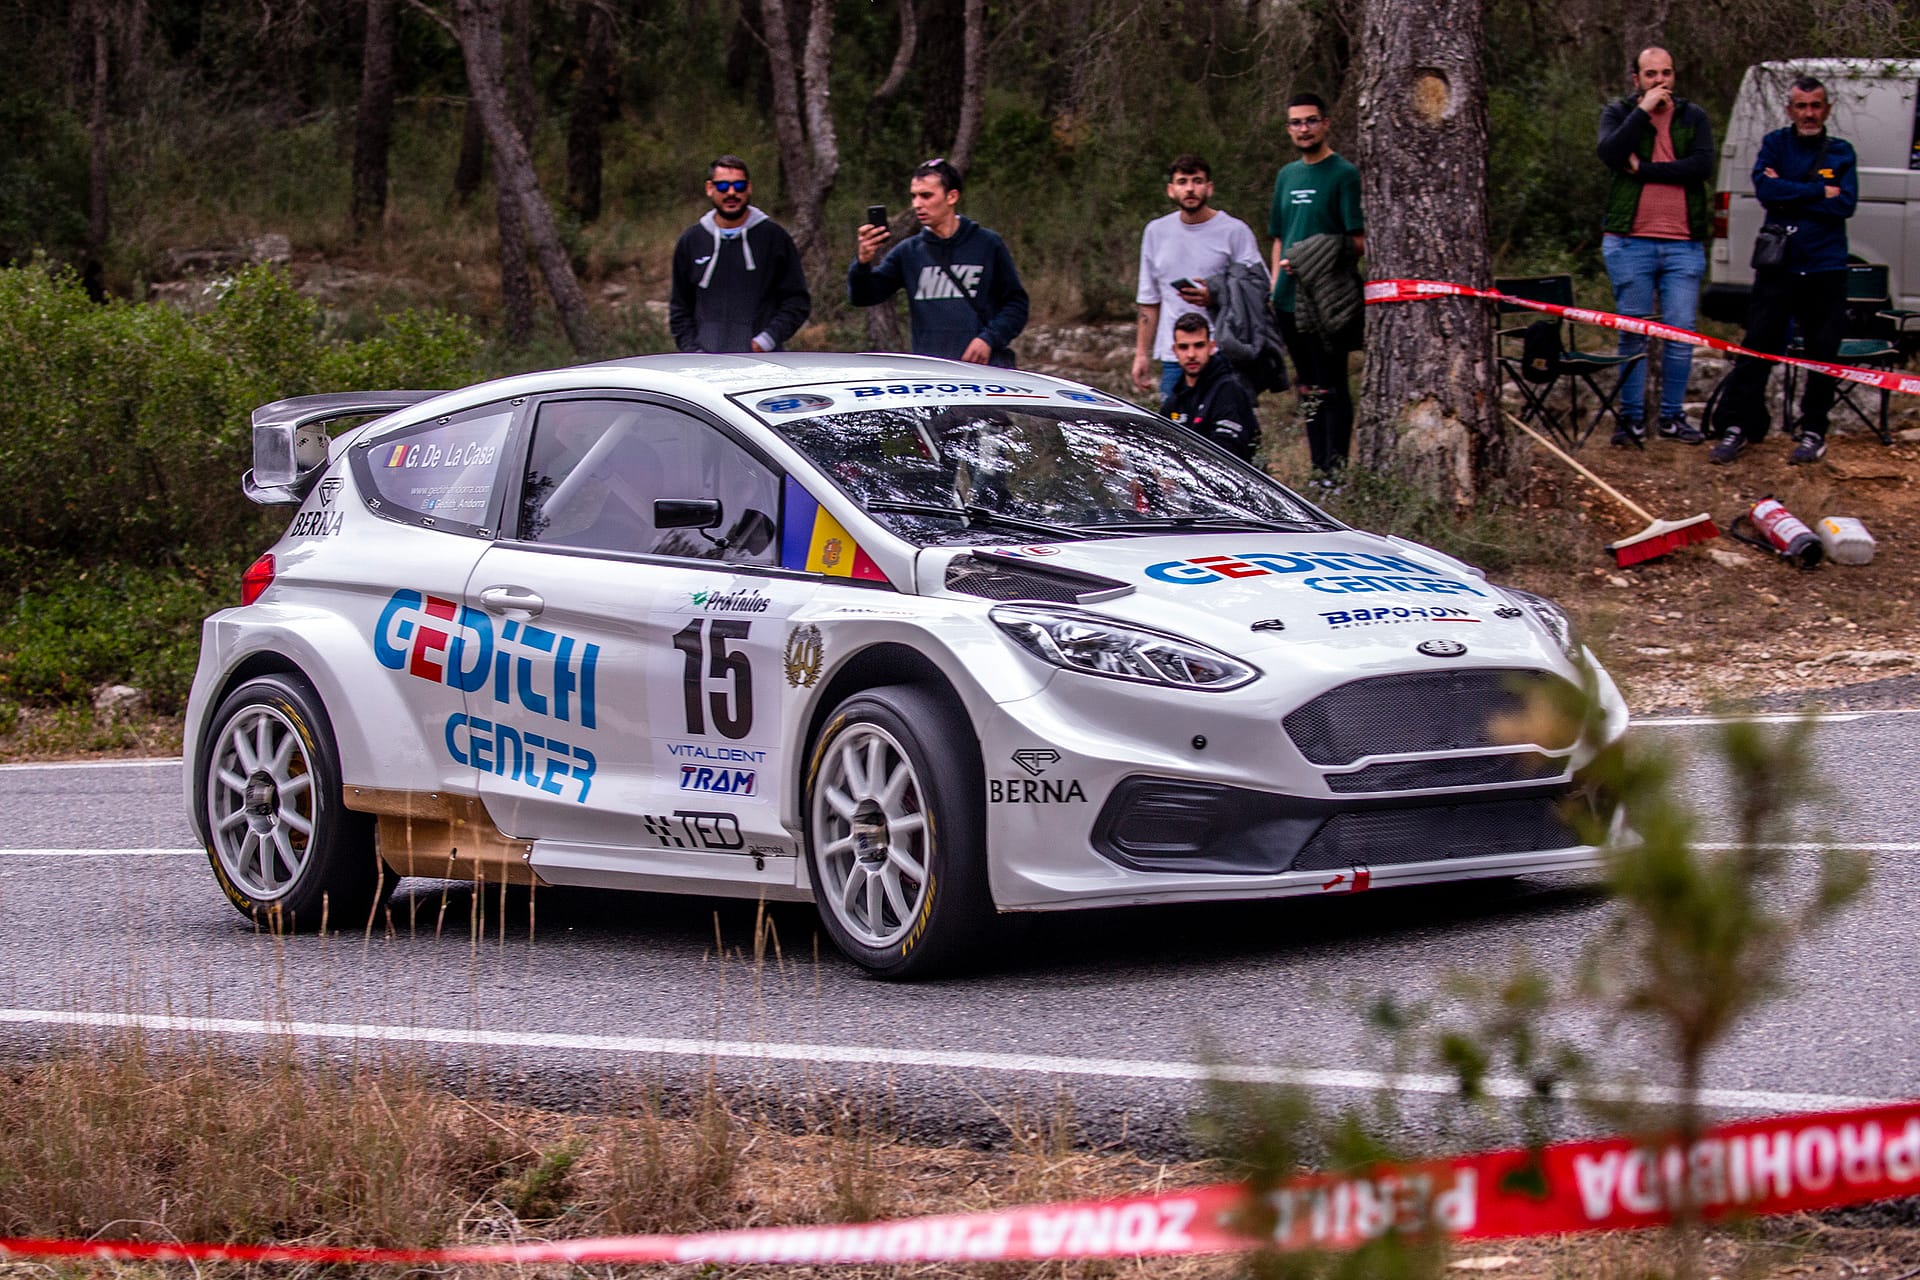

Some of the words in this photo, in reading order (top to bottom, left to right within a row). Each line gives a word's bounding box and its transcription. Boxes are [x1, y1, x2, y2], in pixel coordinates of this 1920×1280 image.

[914, 264, 984, 300] NIKE
[405, 444, 420, 468] G.
[422, 444, 442, 468] De
[444, 442, 463, 467] La
[463, 442, 496, 466] Casa
[290, 511, 344, 537] BERNA
[672, 618, 753, 740] 15
[667, 744, 767, 763] VITALDENT
[681, 765, 756, 794] TRAM
[989, 779, 1088, 803] BERNA
[672, 810, 744, 850] TED
[1573, 1117, 1920, 1220] PROHIBIDA
[1028, 1198, 1199, 1254] ZONA
